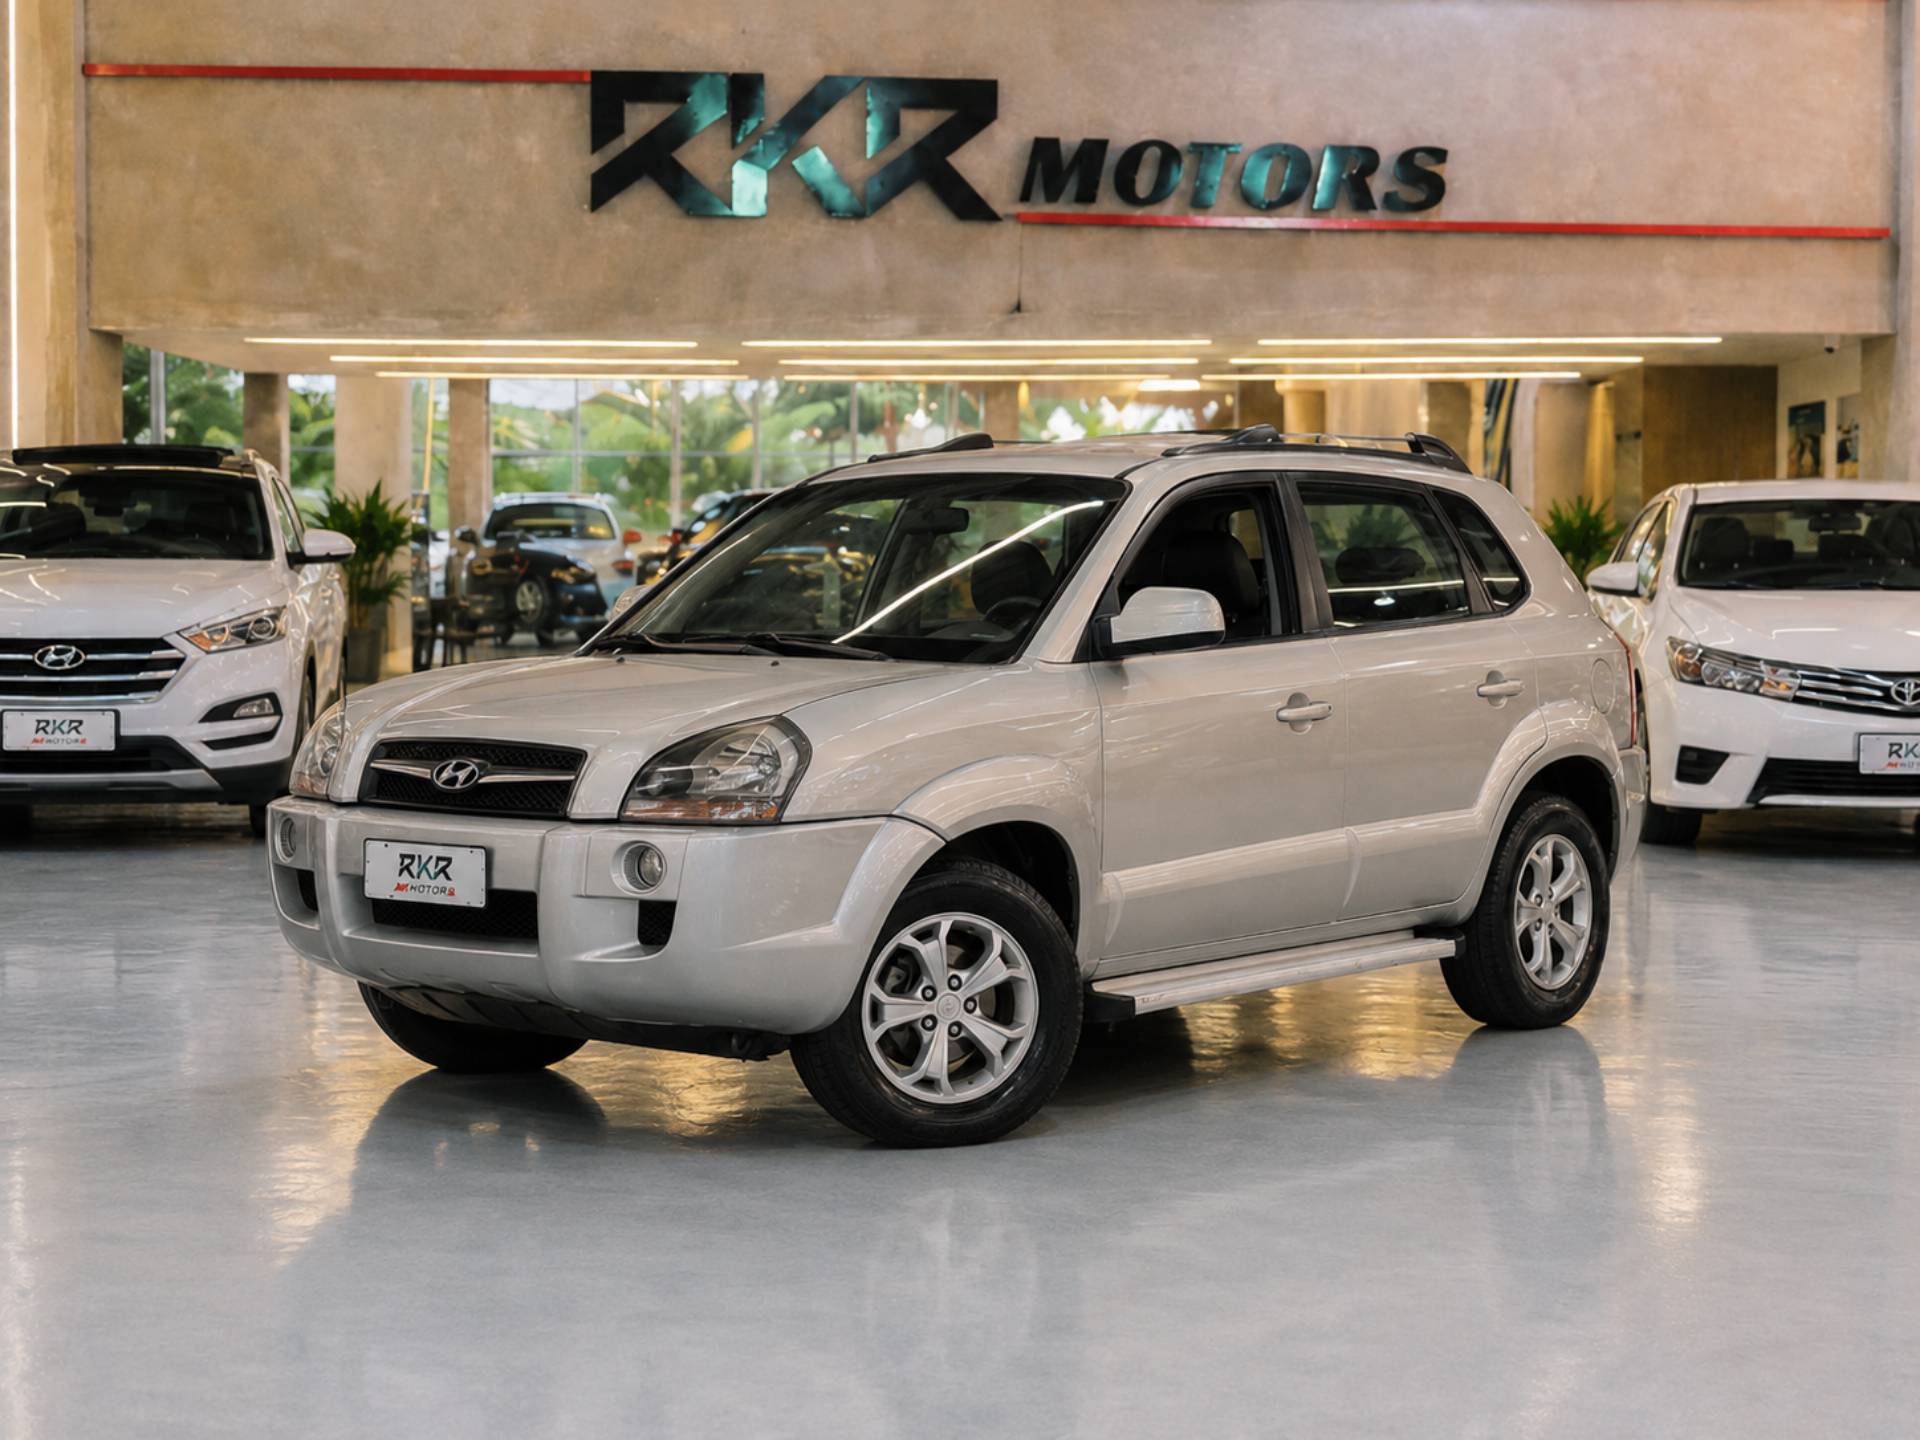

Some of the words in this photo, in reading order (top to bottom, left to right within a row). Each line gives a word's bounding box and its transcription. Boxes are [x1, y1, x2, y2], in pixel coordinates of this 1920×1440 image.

[590, 70, 1003, 221] RKR
[1019, 136, 1448, 212] MOTORS
[35, 719, 84, 735] RKR
[1888, 742, 1920, 759] RK
[398, 853, 453, 881] RKR
